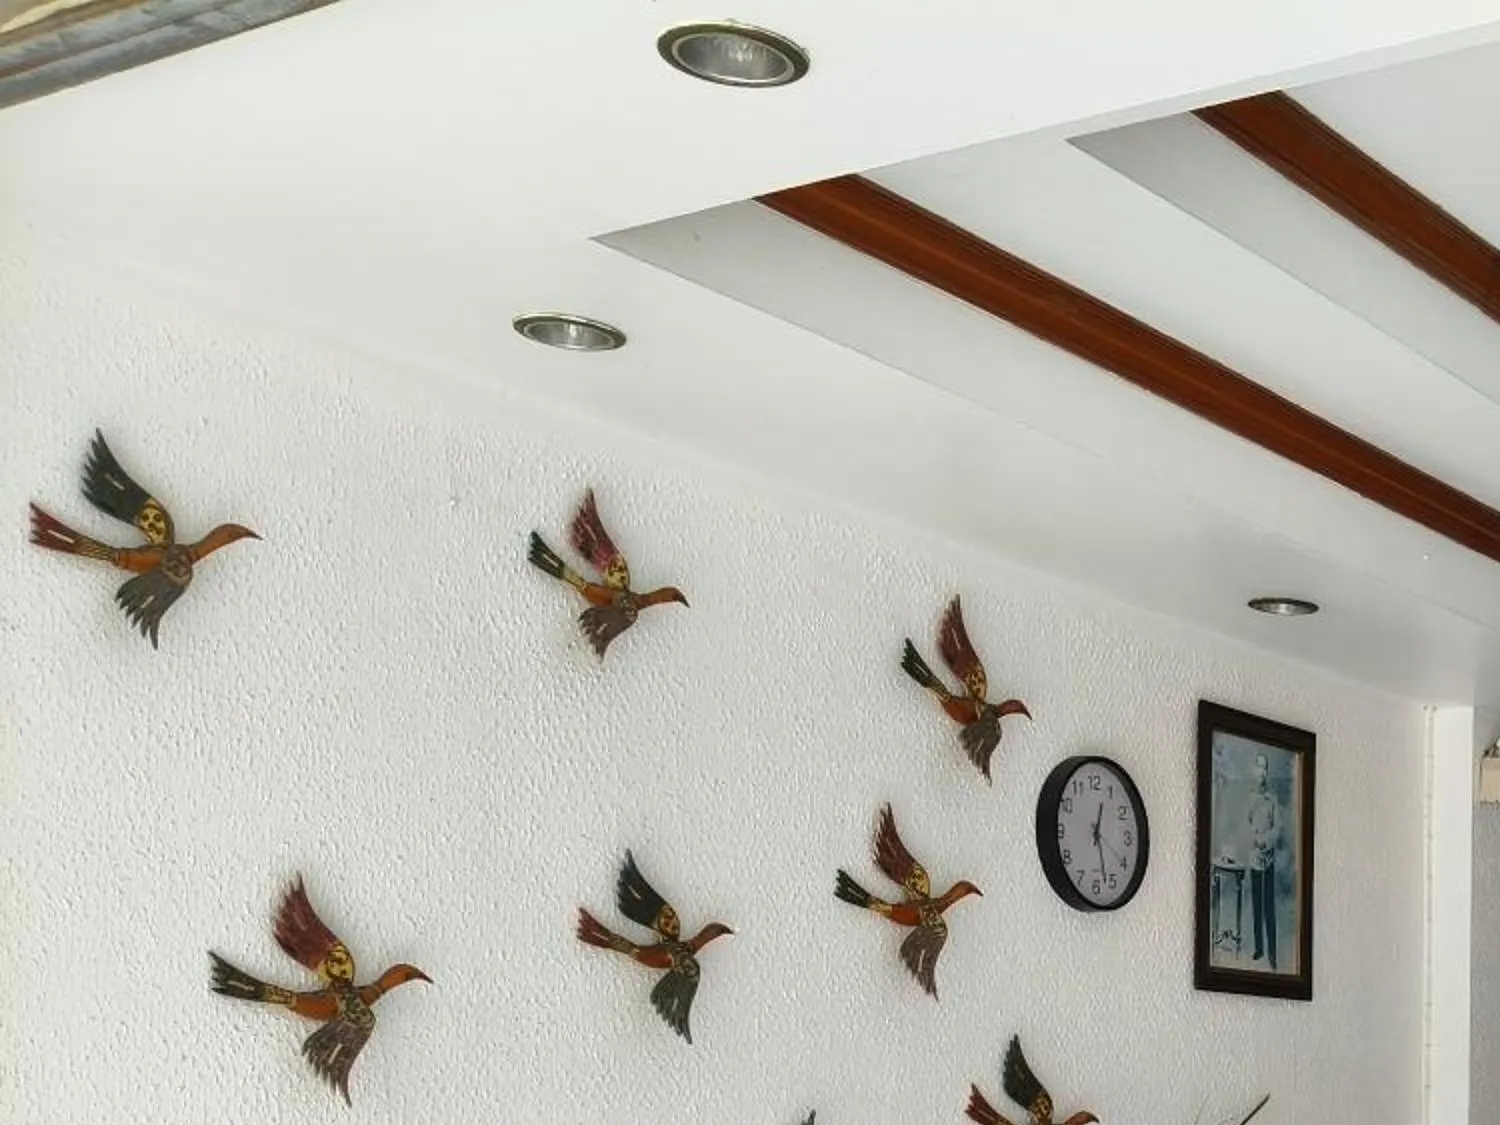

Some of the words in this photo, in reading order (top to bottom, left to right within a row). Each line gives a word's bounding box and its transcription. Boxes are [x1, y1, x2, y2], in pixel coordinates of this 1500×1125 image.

[1072, 780, 1084, 794] 11
[1088, 775, 1100, 790] 12
[1108, 785, 1113, 799] 1
[1061, 798, 1072, 813] 10
[1118, 805, 1127, 820] 2
[1123, 829, 1132, 846] 3
[1063, 849, 1072, 864] 8
[1120, 855, 1127, 871] 4
[1076, 869, 1085, 886] 7
[1108, 873, 1117, 888] 5
[1091, 879, 1101, 894] 6
